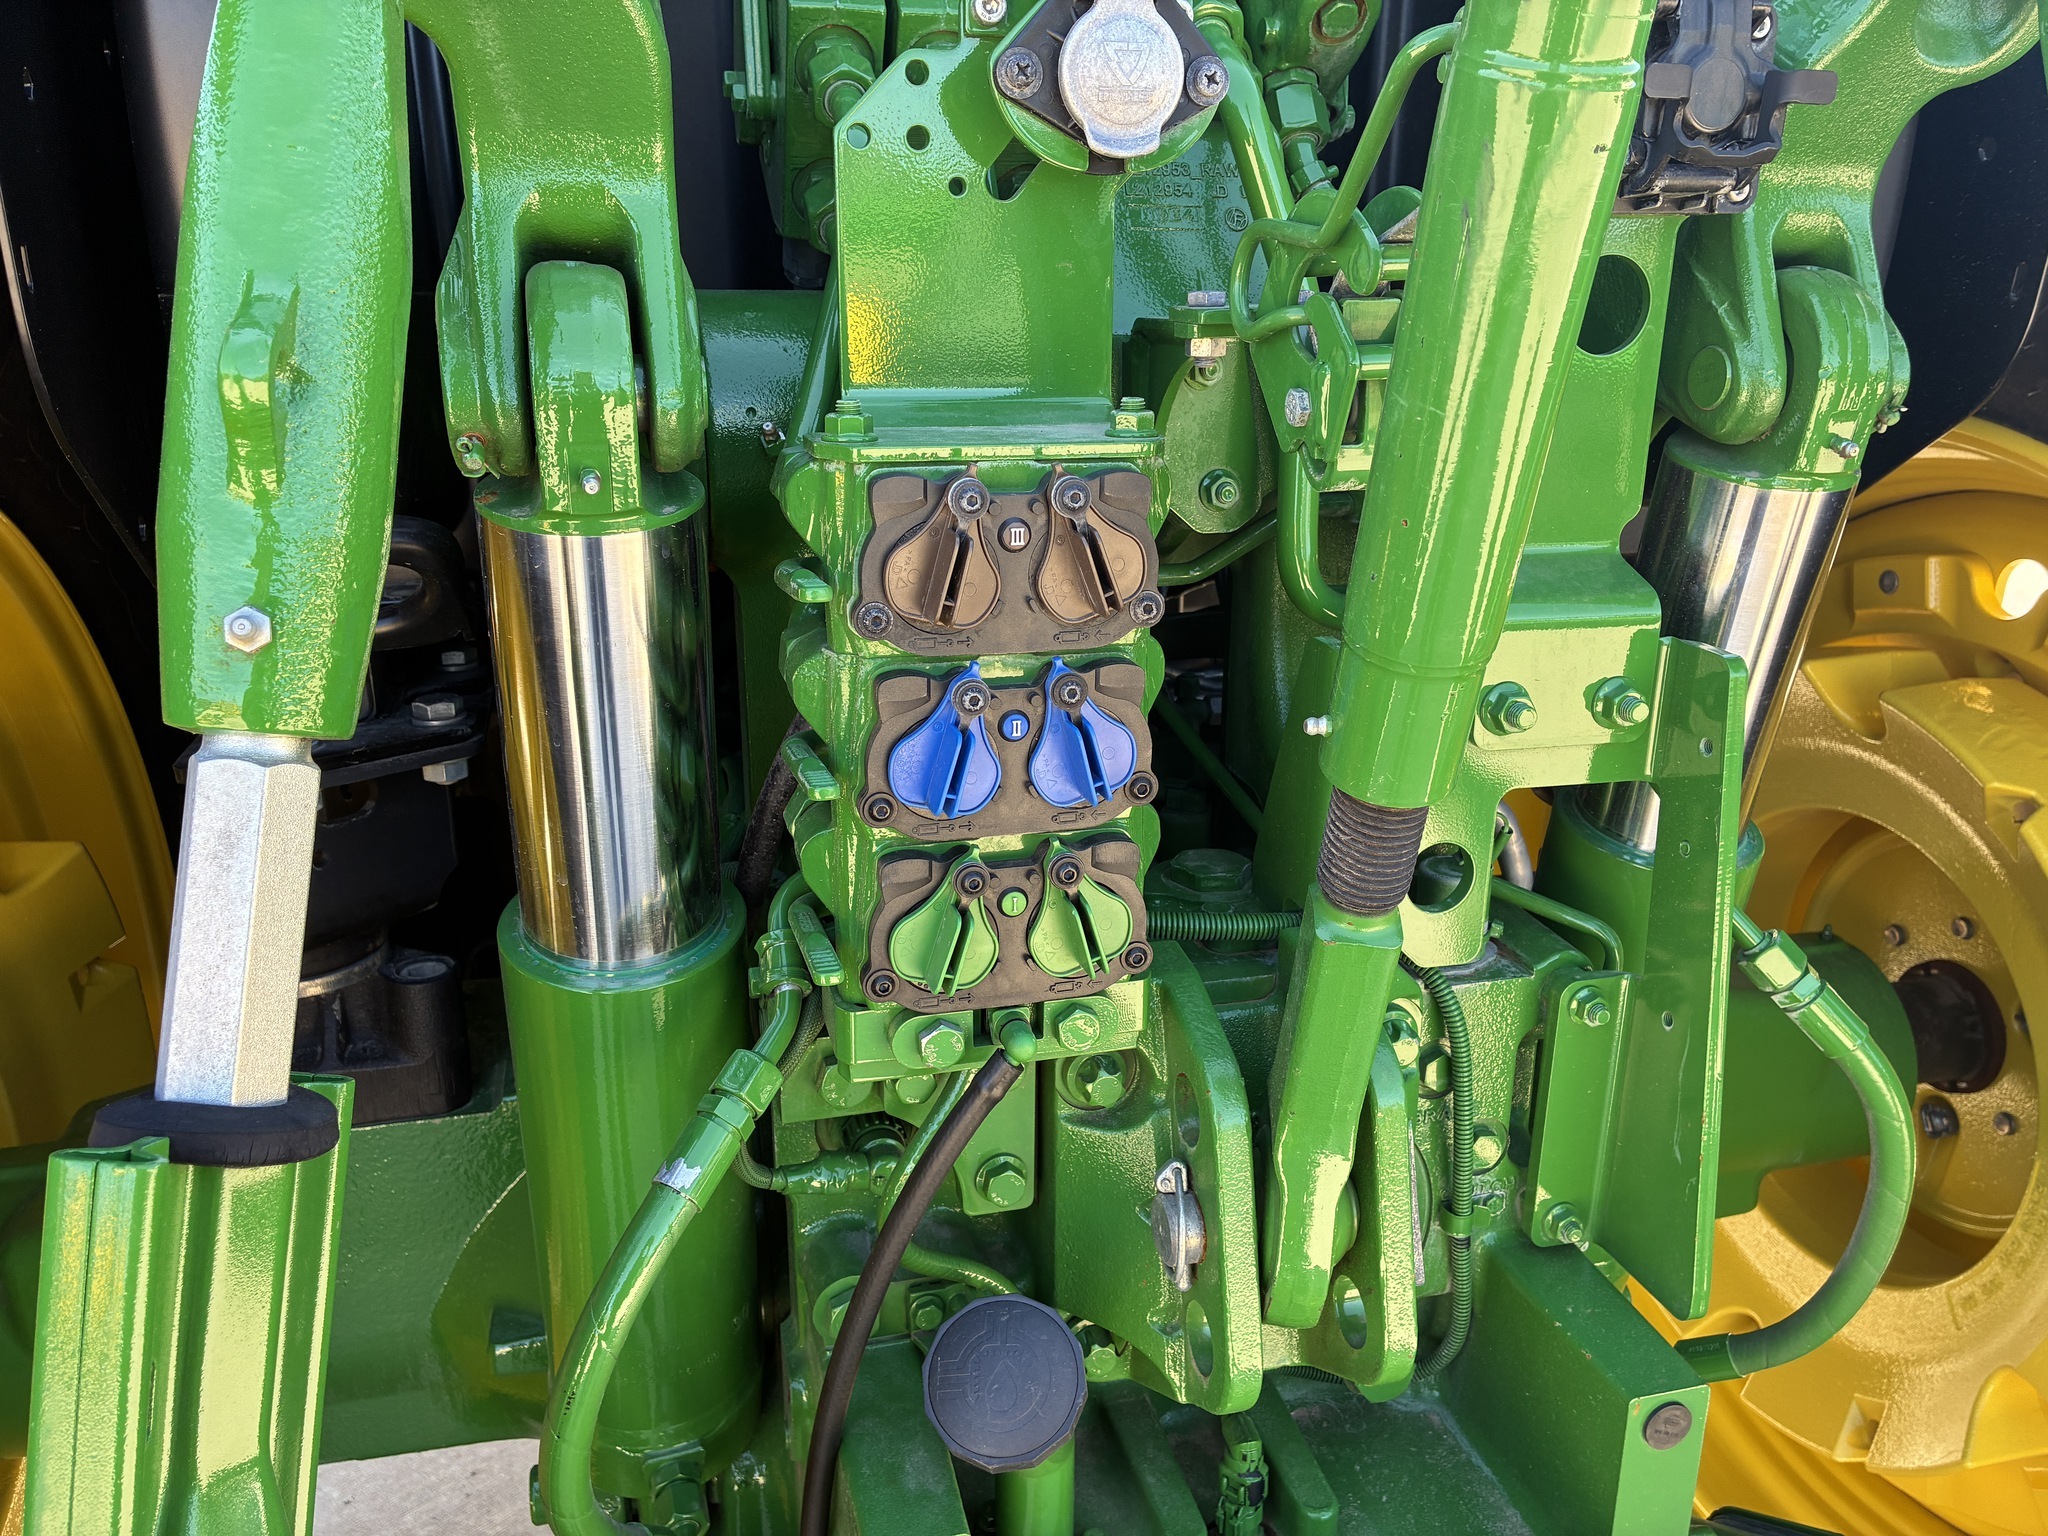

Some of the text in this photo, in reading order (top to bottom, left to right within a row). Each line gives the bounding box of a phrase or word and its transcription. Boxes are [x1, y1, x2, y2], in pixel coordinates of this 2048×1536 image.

[1132, 162, 1239, 180] 2953_RAW
[1123, 184, 1193, 198] L212954
[1010, 528, 1025, 546] III
[1011, 720, 1022, 737] II
[1012, 897, 1018, 913] I
